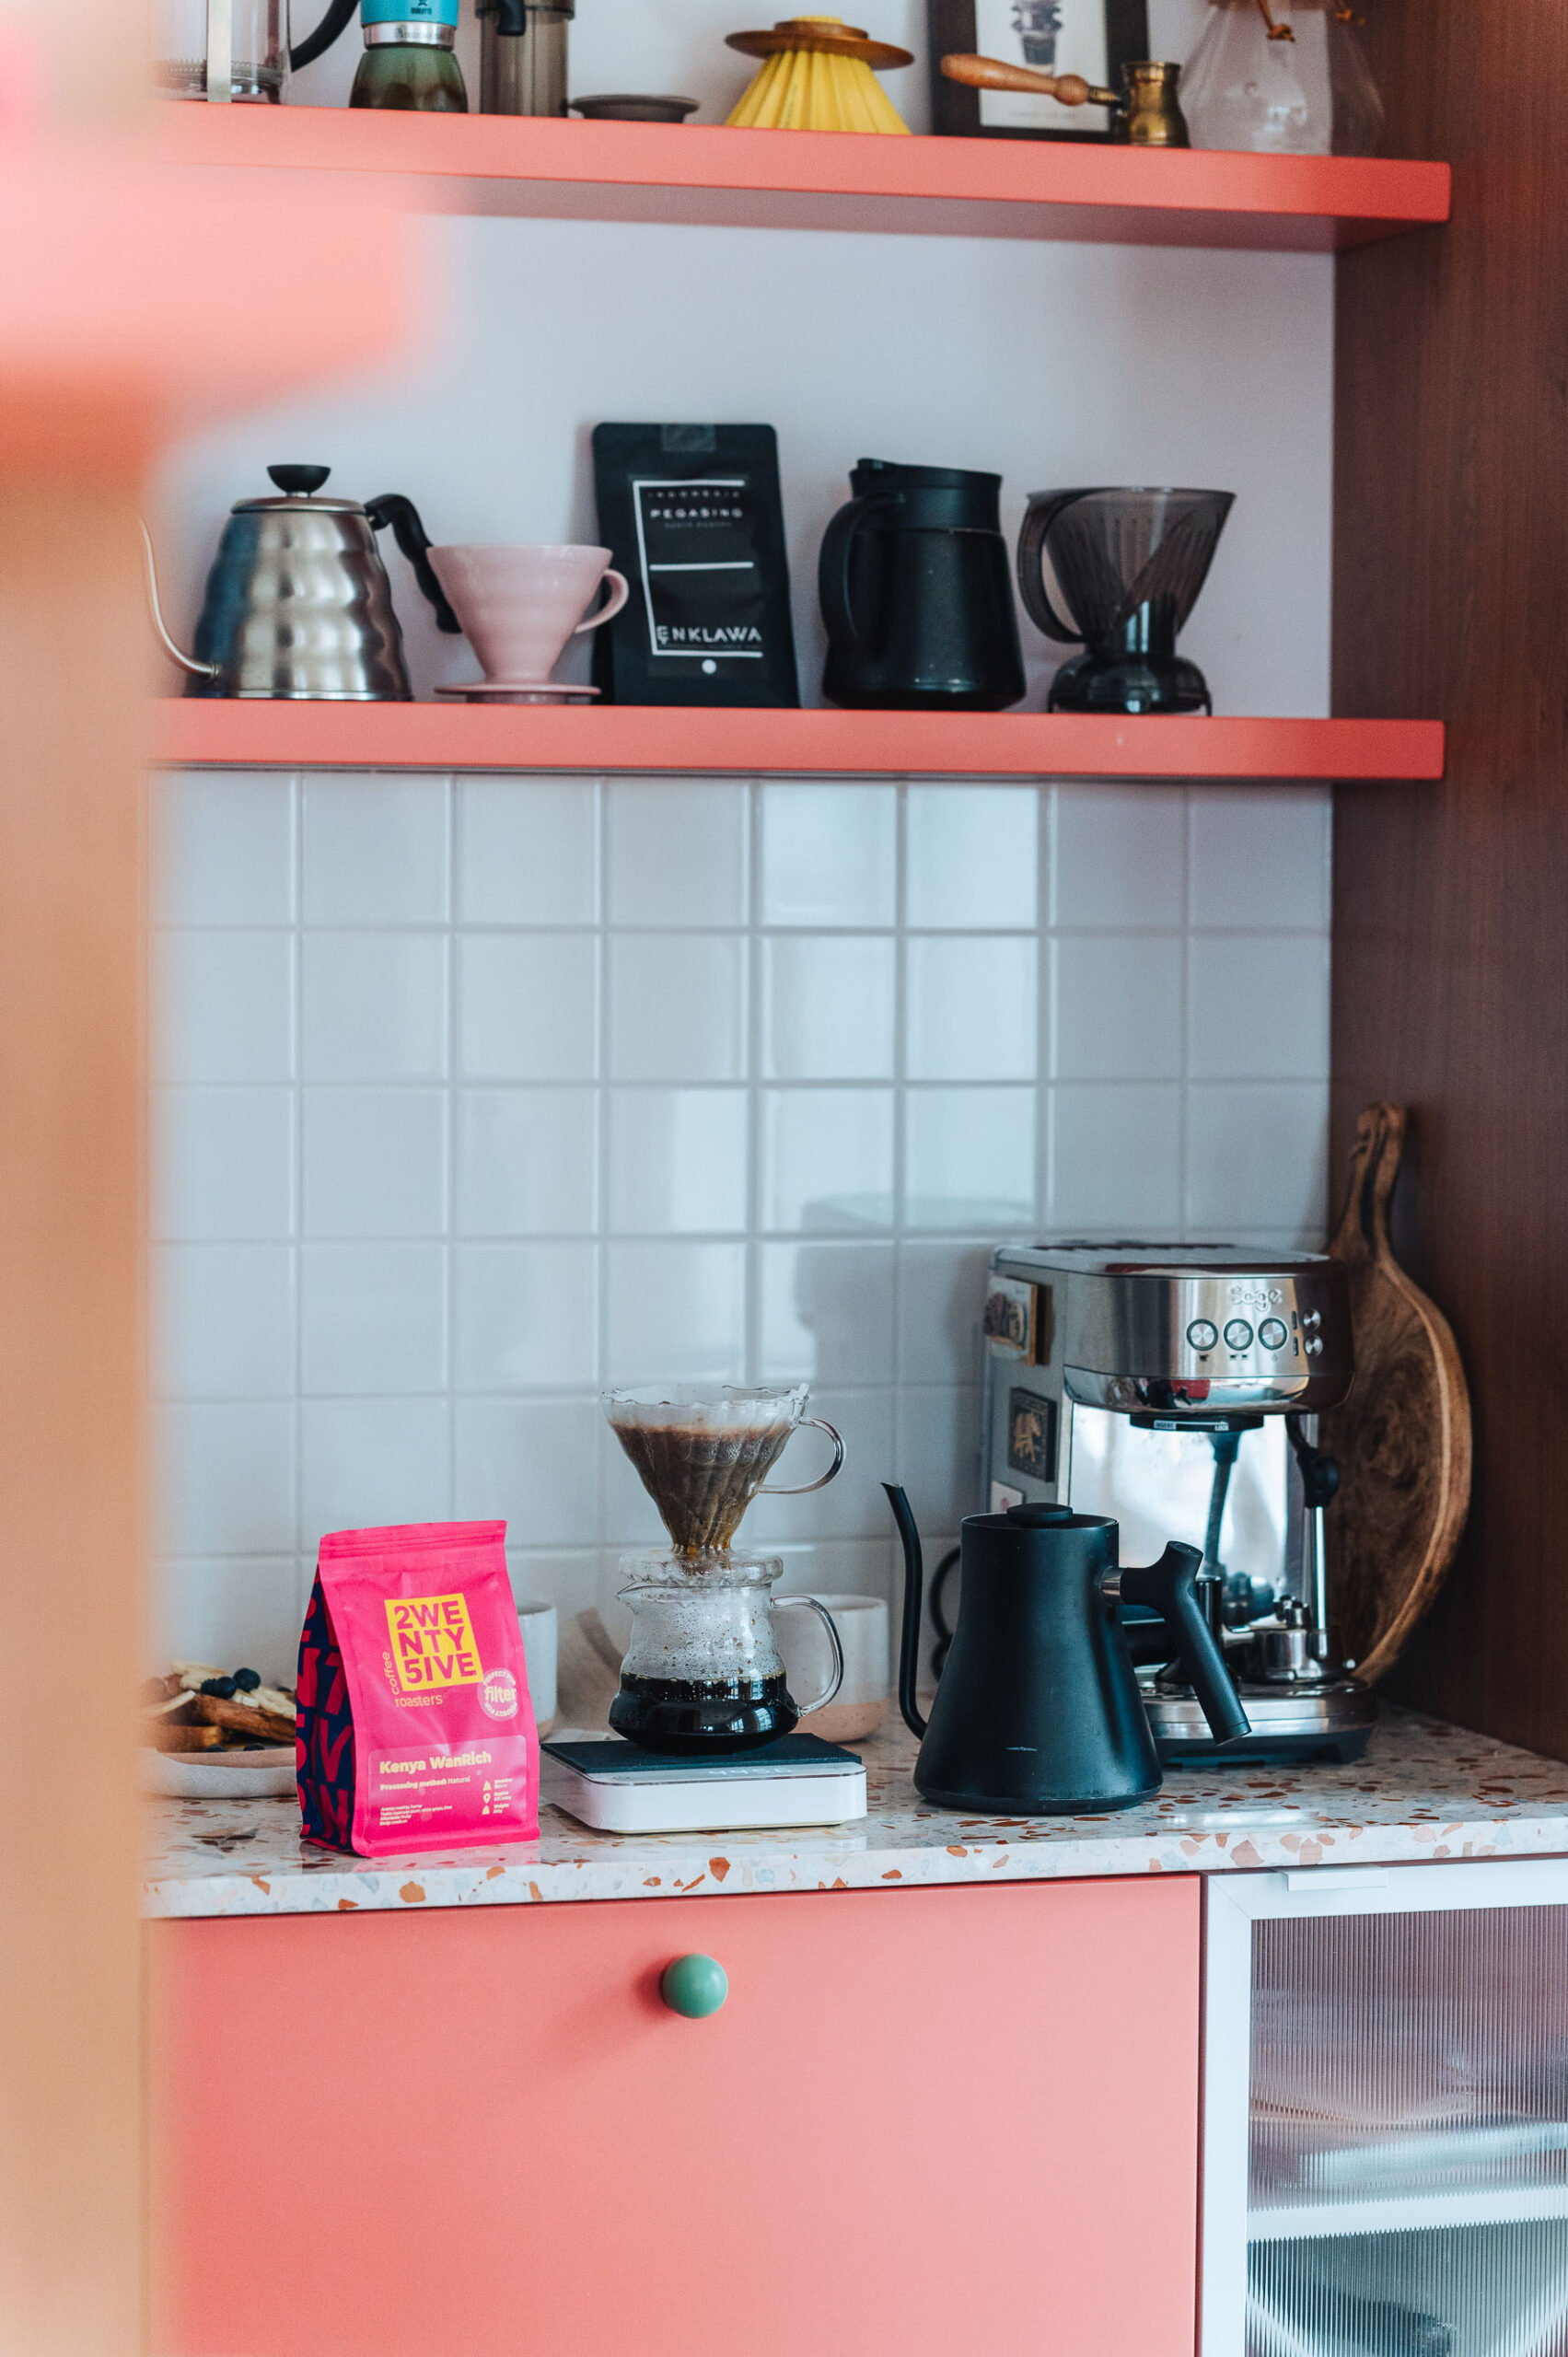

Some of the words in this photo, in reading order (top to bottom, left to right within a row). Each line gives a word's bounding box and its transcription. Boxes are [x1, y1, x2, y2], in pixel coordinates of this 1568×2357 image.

[650, 507, 742, 519] PEGASING
[1230, 1285, 1283, 1312] Sage
[393, 1600, 464, 1630] 2WE
[398, 1626, 464, 1657] NTY
[382, 1651, 401, 1695] coffee
[403, 1652, 477, 1684] 5IVE
[395, 1694, 443, 1707] roasters
[483, 1686, 517, 1703] filter
[379, 1759, 426, 1775] Kenya
[429, 1750, 493, 1770] WanRich
[447, 1775, 470, 1784] Natural
